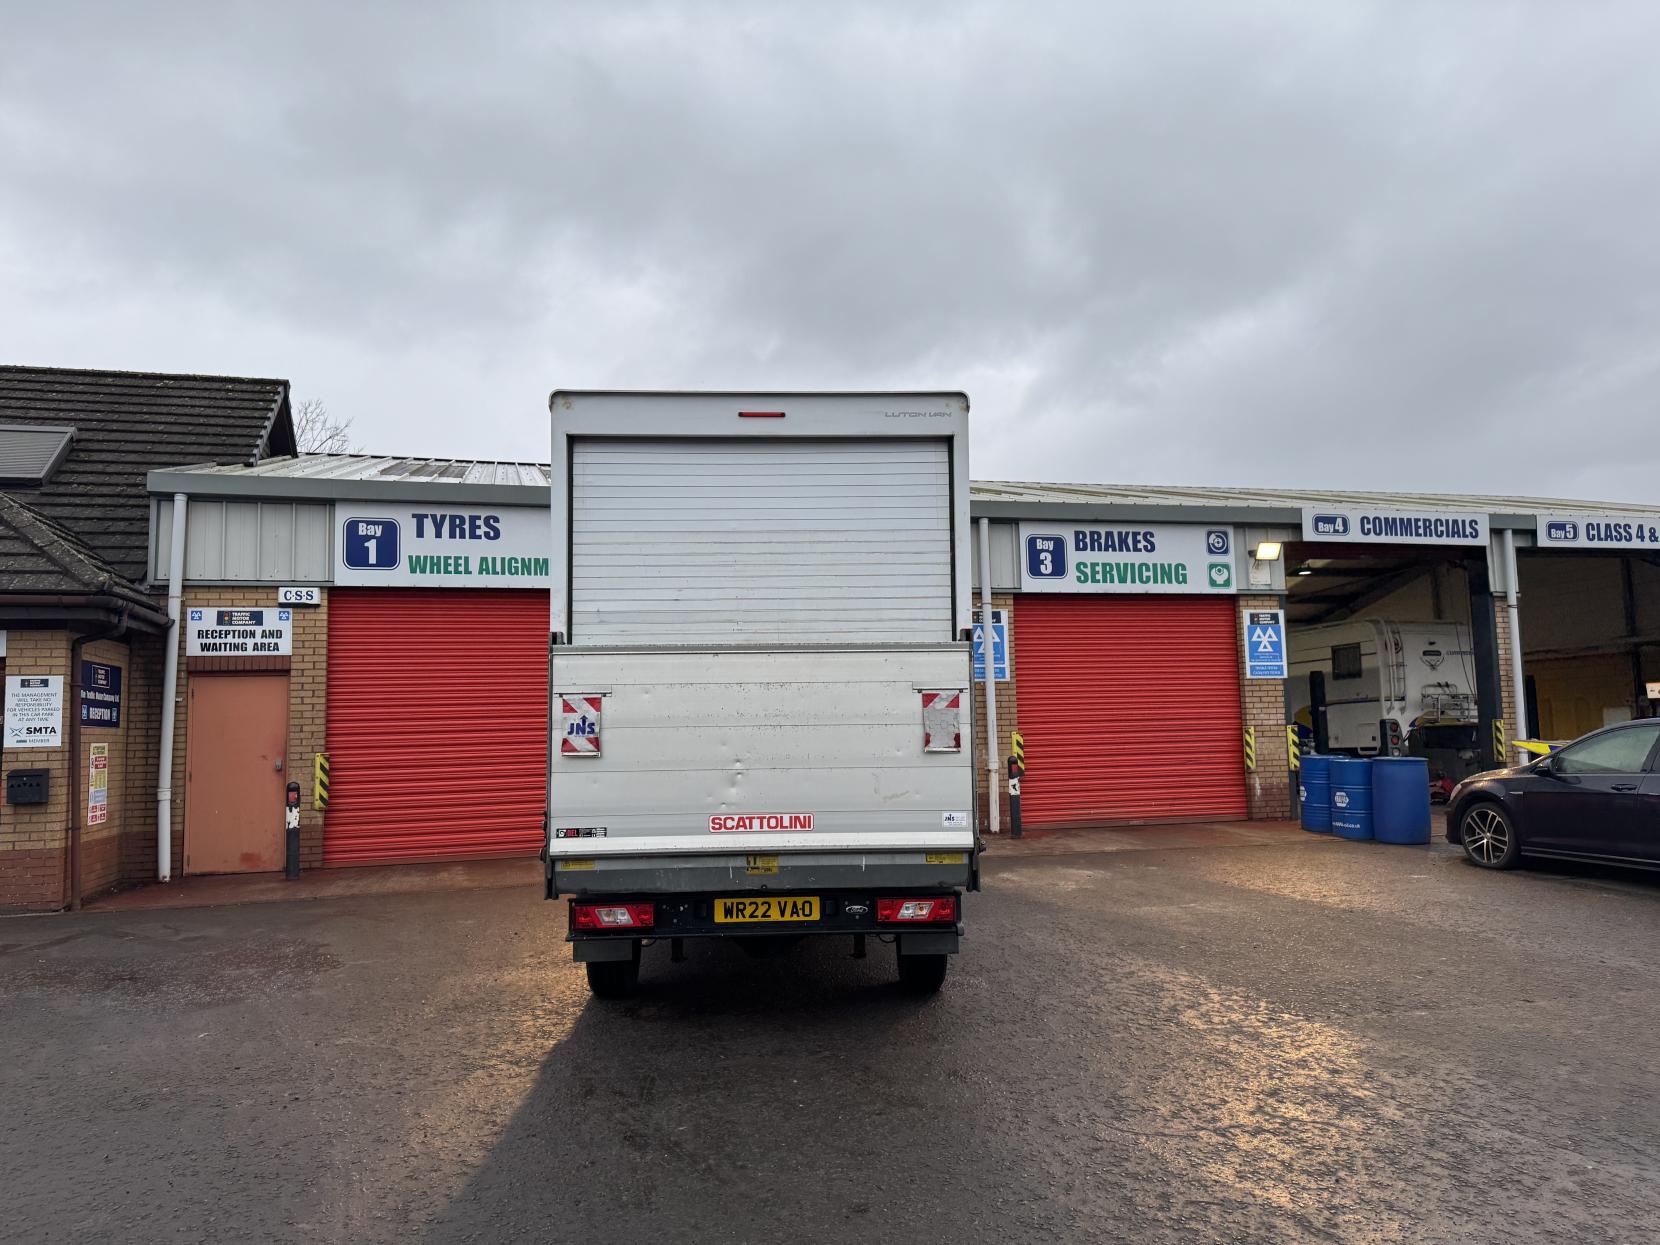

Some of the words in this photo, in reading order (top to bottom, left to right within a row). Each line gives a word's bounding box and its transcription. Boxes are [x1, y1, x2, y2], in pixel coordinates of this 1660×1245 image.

[358, 522, 383, 537] Bay
[411, 513, 501, 541] TYRES
[1318, 522, 1334, 533] Bay
[1335, 517, 1344, 532] 4
[1360, 516, 1479, 539] COMMERCIALS
[1551, 528, 1565, 539] Bay
[1565, 524, 1574, 539] 5
[1585, 522, 1633, 542] CLASS
[1635, 523, 1646, 542] 4
[1648, 526, 1659, 543] &
[1036, 538, 1054, 551] Bay
[1074, 530, 1156, 552] BRAKES
[364, 538, 377, 565] 1
[408, 555, 472, 575] WHEEL
[478, 556, 549, 576] ALIGNM
[1039, 551, 1053, 575] 3
[1075, 562, 1188, 584] SERVICING
[197, 629, 256, 639] RECEPTION
[260, 629, 283, 639] AND
[200, 642, 248, 652] WAITING
[252, 642, 280, 652] AREA
[89, 706, 111, 720] RECEPTION
[26, 726, 57, 735] SMTA
[567, 720, 596, 735] JNS
[711, 815, 812, 831] SCATTOLINI
[723, 901, 772, 919] WR22
[778, 900, 813, 918] VAO
